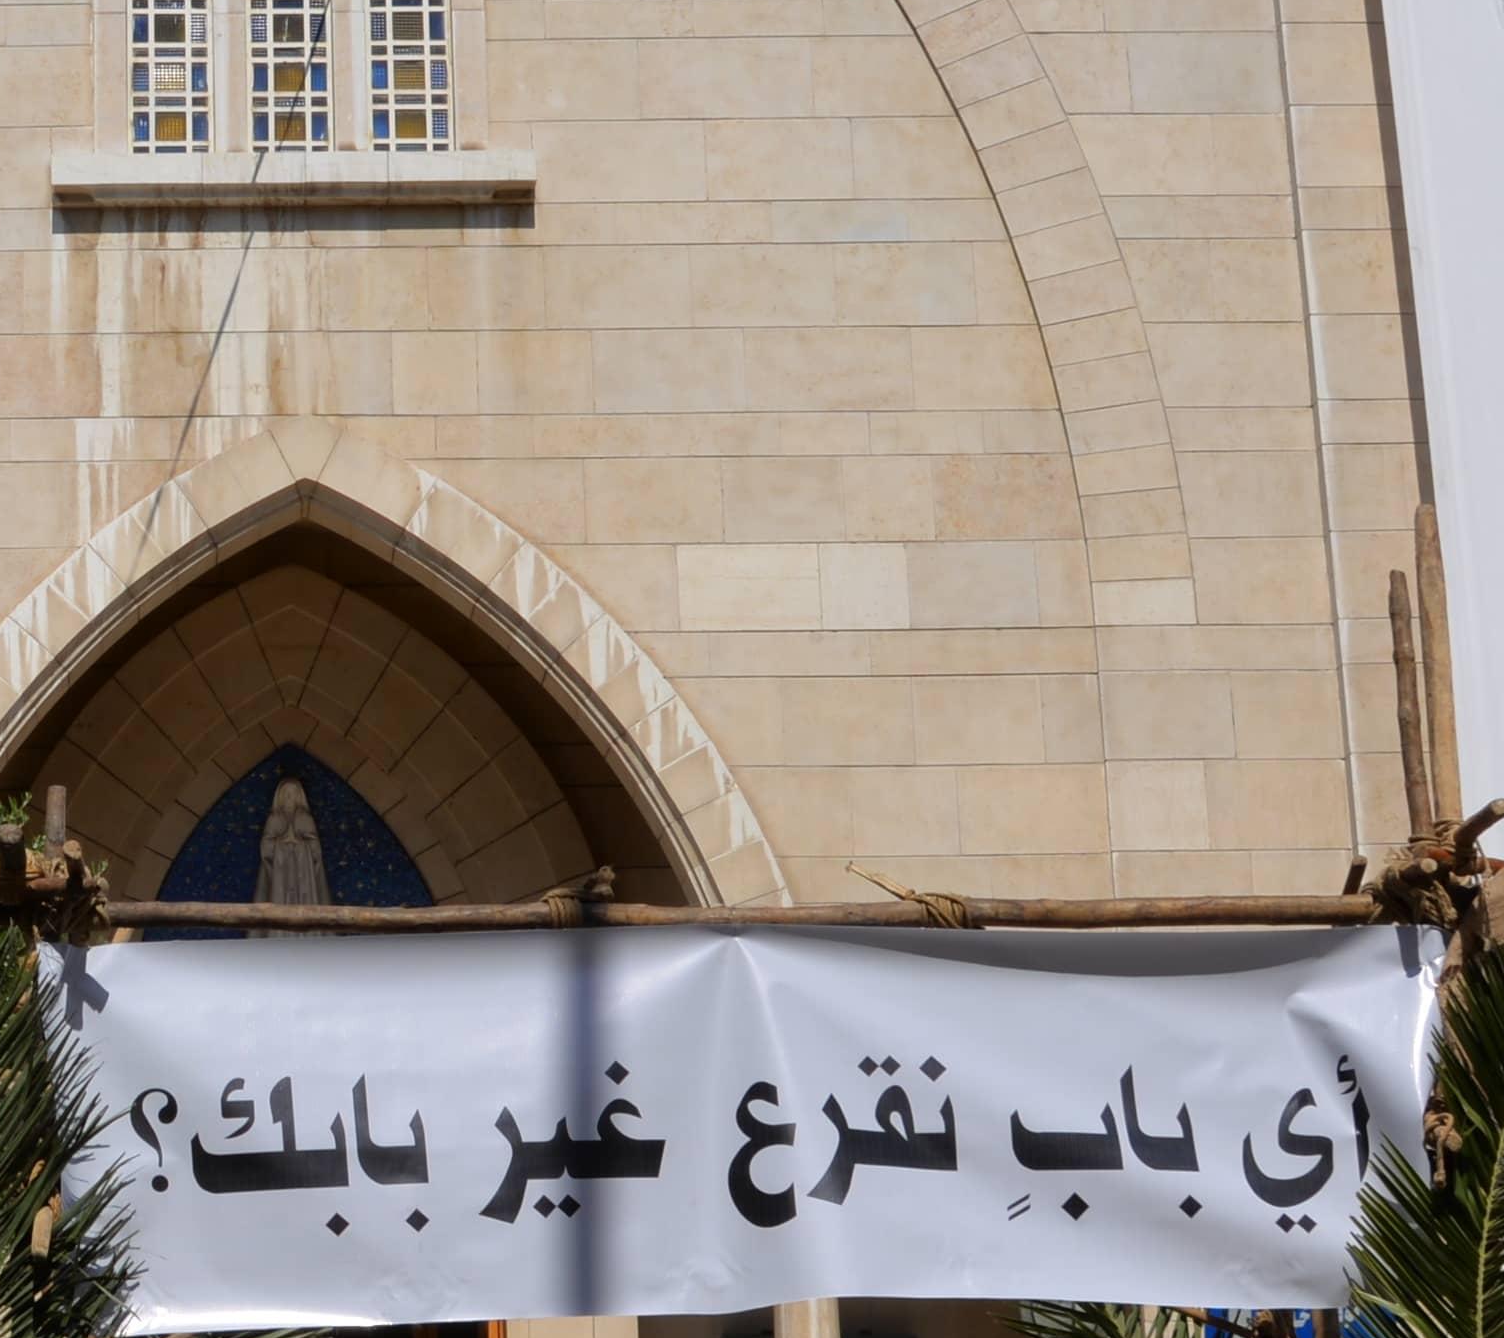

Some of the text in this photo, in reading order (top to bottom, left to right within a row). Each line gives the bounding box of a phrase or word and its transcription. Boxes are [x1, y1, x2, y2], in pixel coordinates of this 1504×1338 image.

[128, 1073, 430, 1237] بابك؟
[478, 1061, 666, 1223] غير
[727, 1056, 958, 1229] نقرع
[1243, 1054, 1371, 1234] أي
